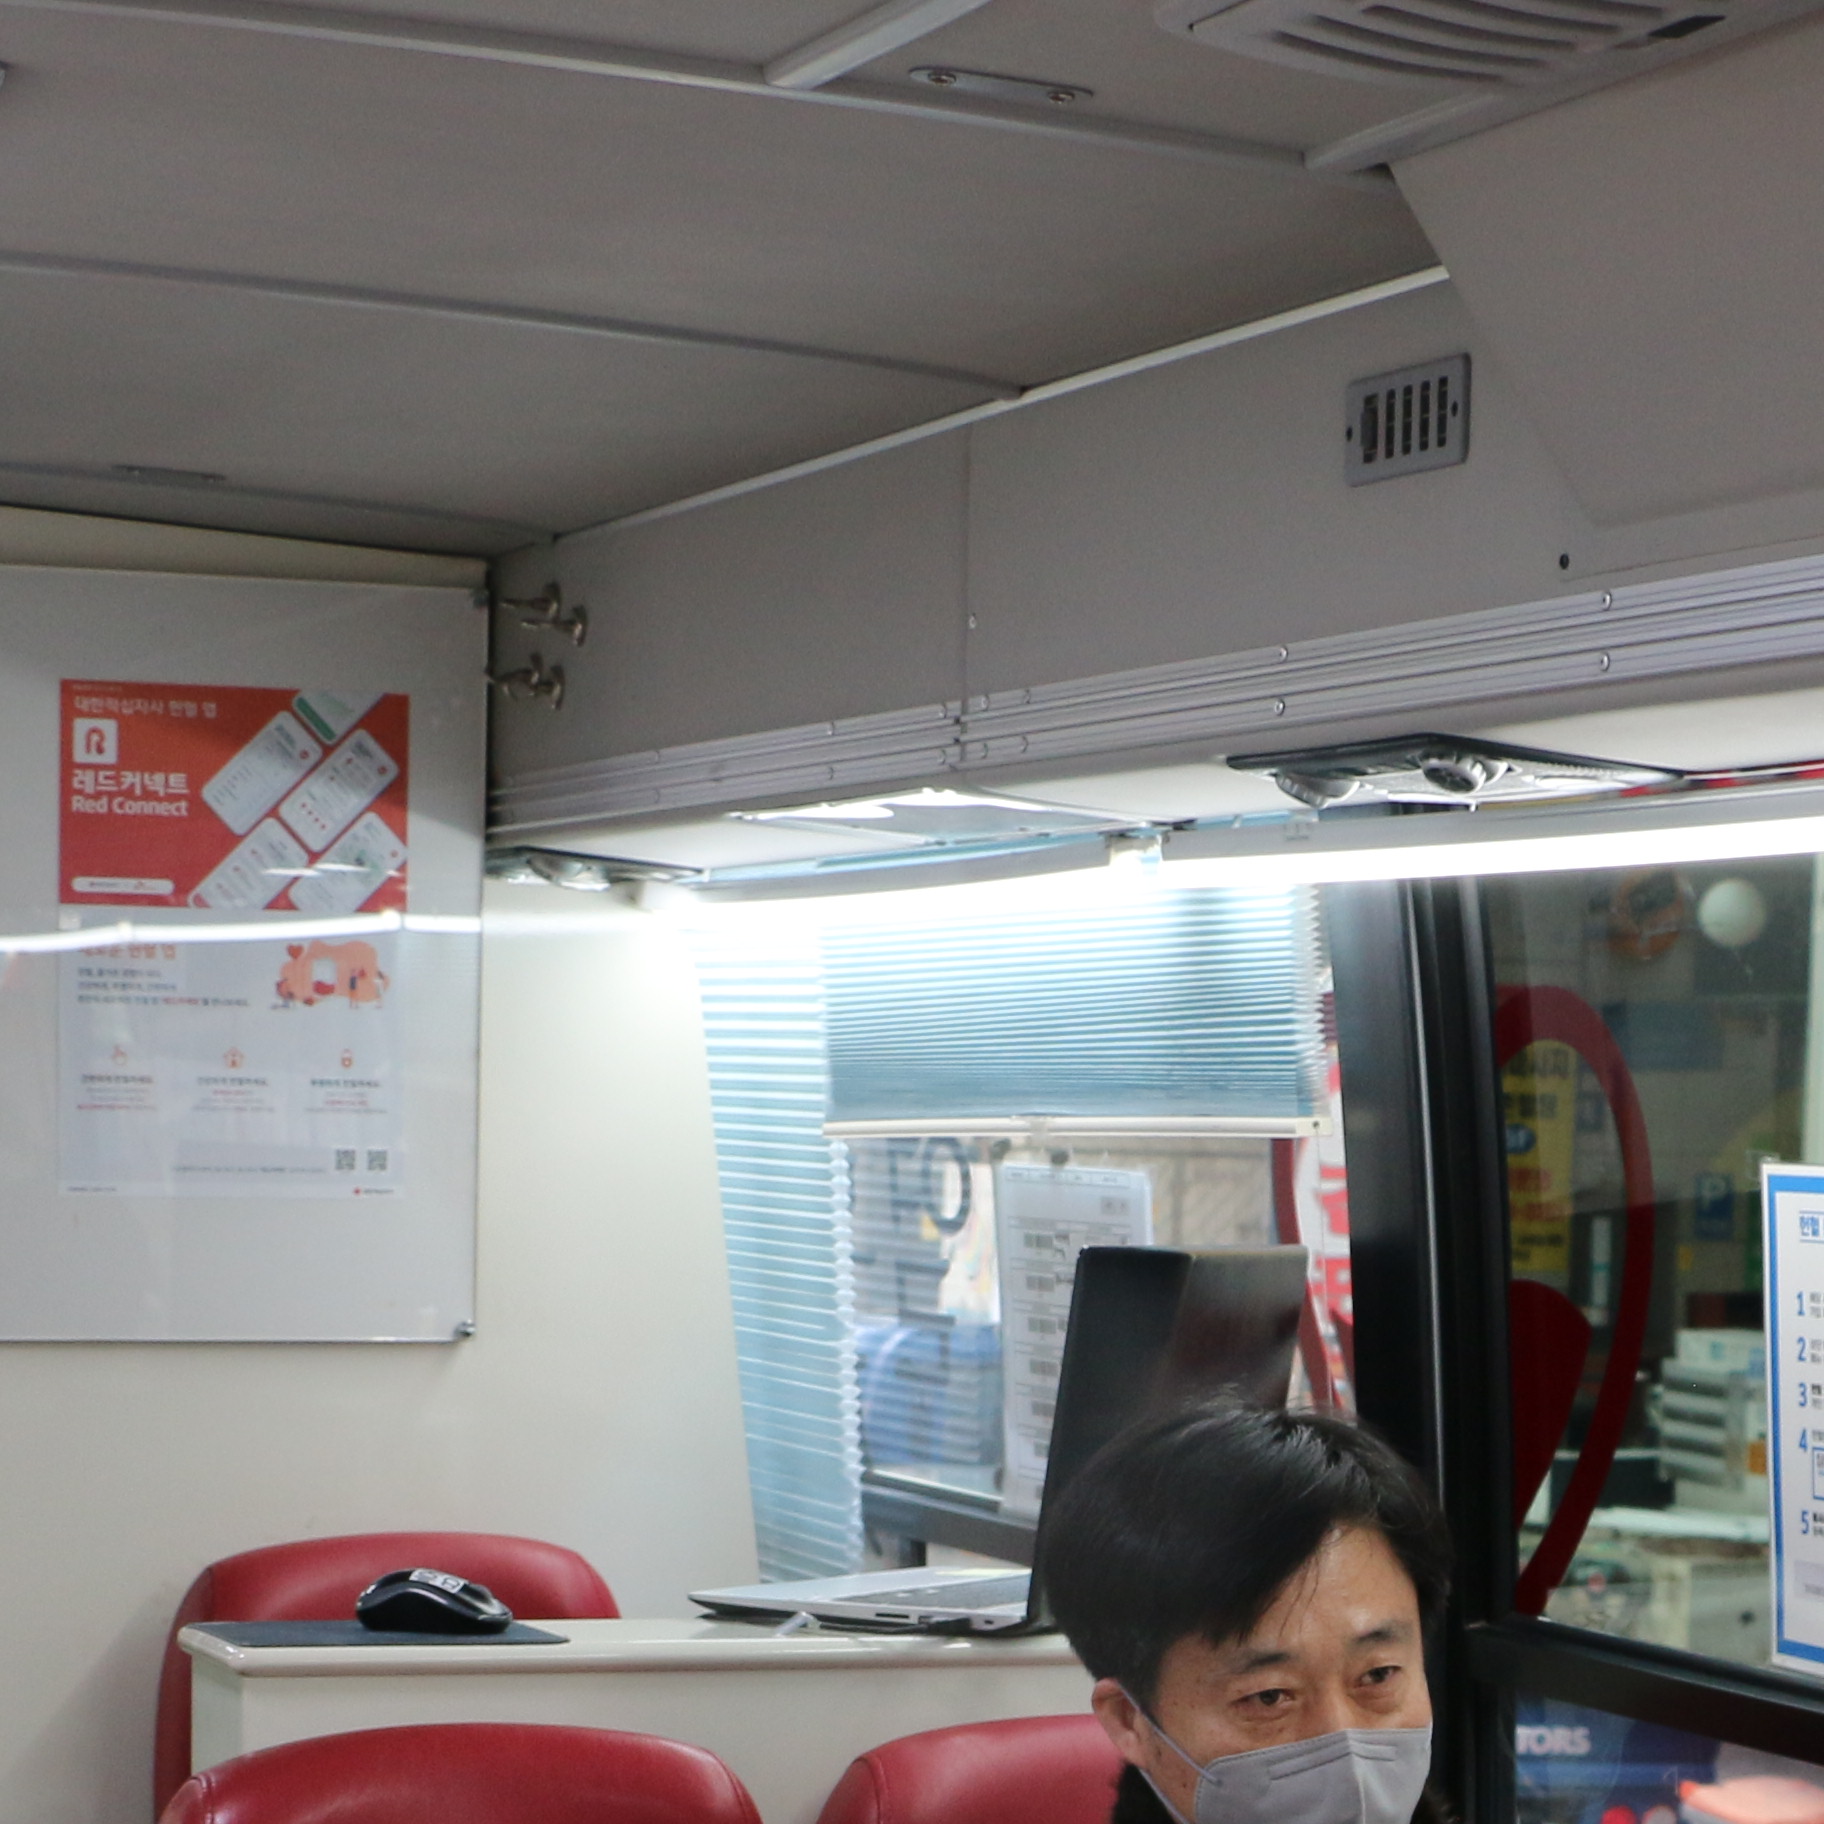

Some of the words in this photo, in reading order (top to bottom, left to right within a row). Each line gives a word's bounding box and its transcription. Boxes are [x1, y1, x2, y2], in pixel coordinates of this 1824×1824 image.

[73, 769, 189, 796] 레드커넥트
[72, 796, 108, 813] Red
[112, 798, 188, 816] Connect
[1799, 1216, 1819, 1237] 헌혈
[1797, 1291, 1805, 1316] 1
[1797, 1337, 1806, 1362] 2
[1798, 1383, 1807, 1407] 3
[1799, 1429, 1807, 1453] 4
[1801, 1511, 1809, 1534] 5
